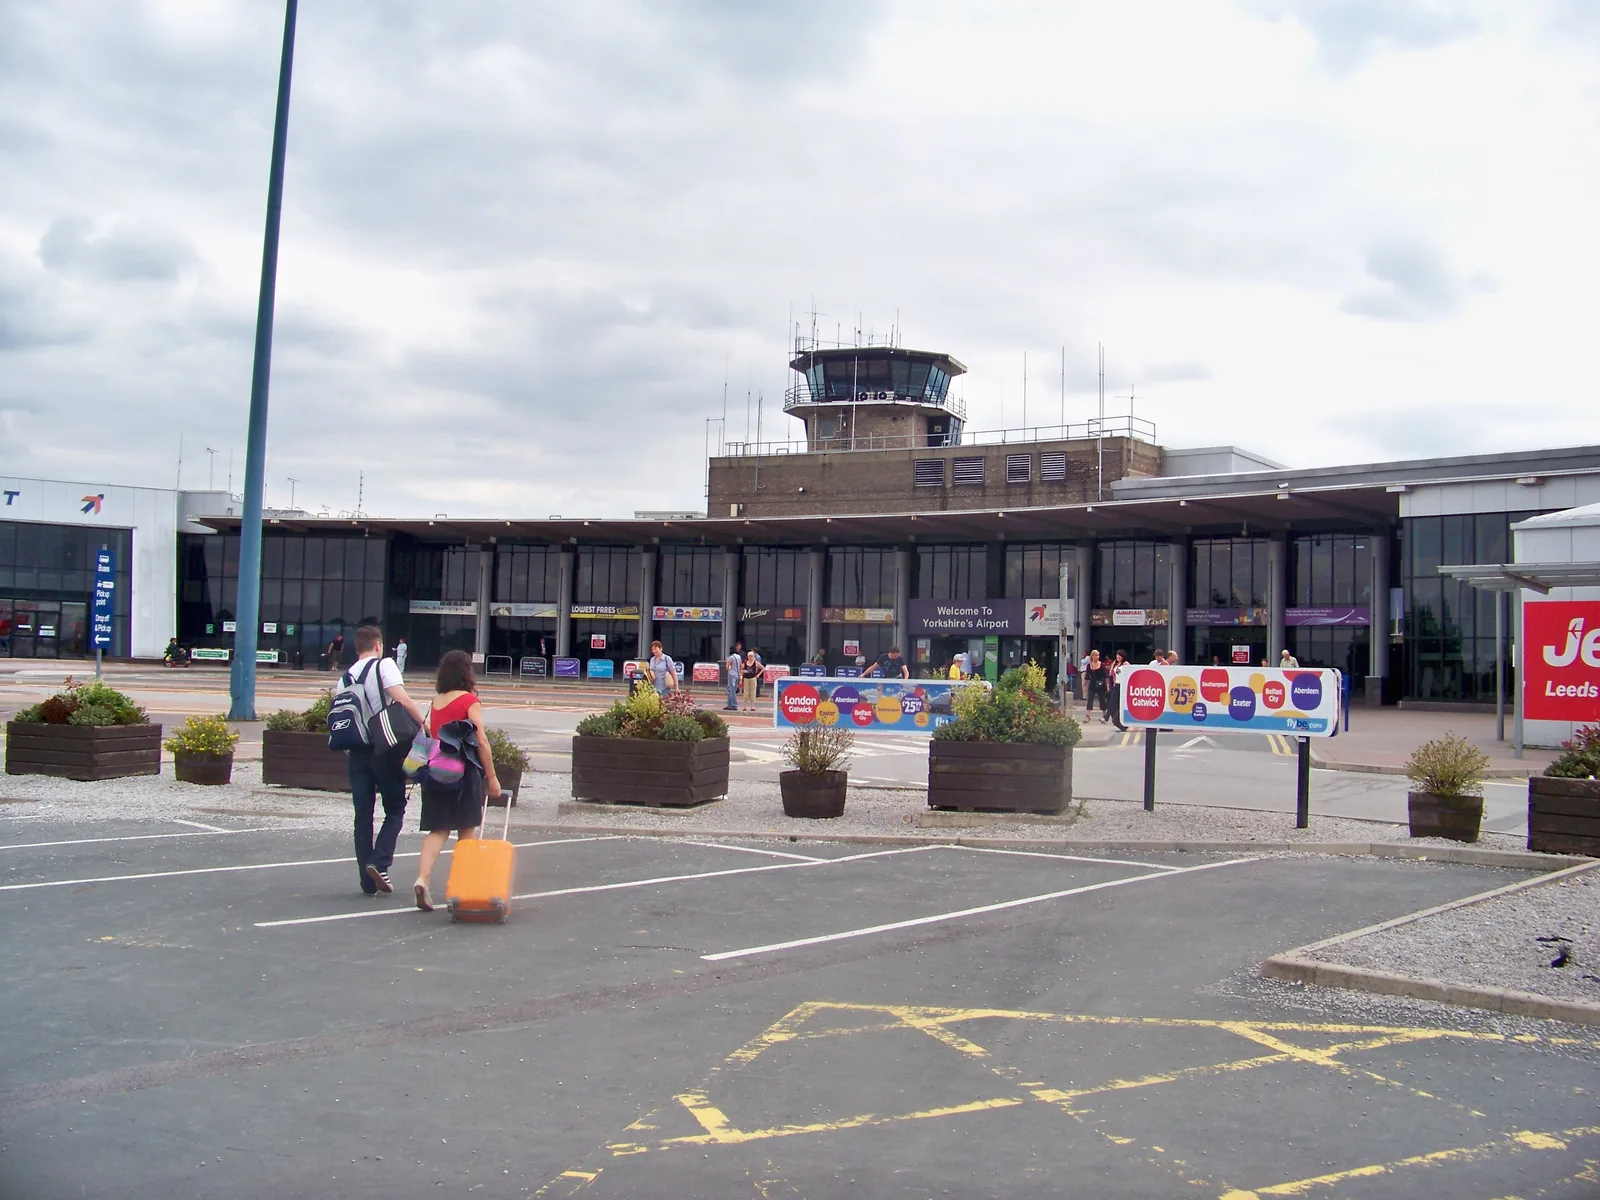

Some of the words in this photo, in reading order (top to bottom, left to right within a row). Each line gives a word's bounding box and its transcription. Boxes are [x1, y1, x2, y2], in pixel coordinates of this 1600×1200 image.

[596, 606, 615, 614] FARES
[937, 606, 979, 616] Welcome
[982, 606, 993, 615] To
[922, 619, 973, 628] Yorkshire's
[976, 619, 1009, 629] Airport
[1130, 686, 1162, 697] London
[1294, 687, 1320, 695] Aberdeen
[1545, 681, 1599, 698] Leeds
[784, 696, 817, 705] London
[1132, 698, 1159, 707] Gatwick
[1233, 699, 1252, 707] Exeter
[1268, 695, 1279, 703] City
[1287, 718, 1322, 729] flybe.com
